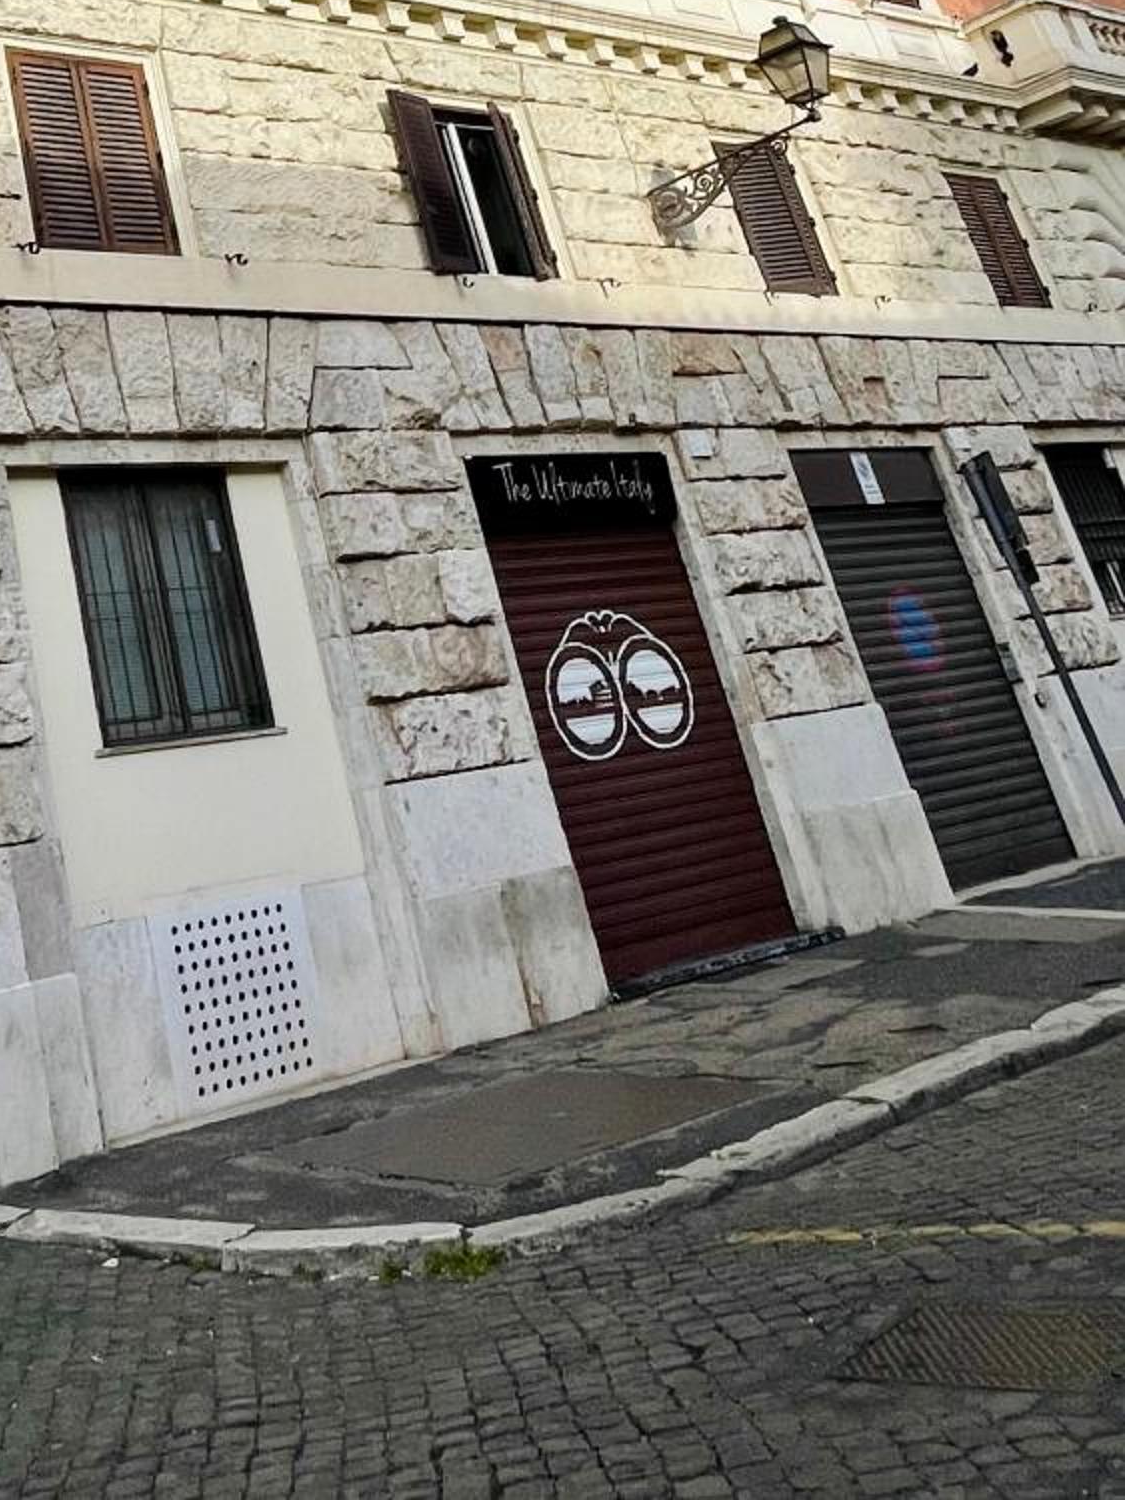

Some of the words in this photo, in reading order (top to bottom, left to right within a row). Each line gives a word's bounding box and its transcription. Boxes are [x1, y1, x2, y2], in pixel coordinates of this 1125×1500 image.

[492, 461, 532, 501] The
[531, 461, 612, 505] Ultimate
[610, 459, 656, 515] Italy
